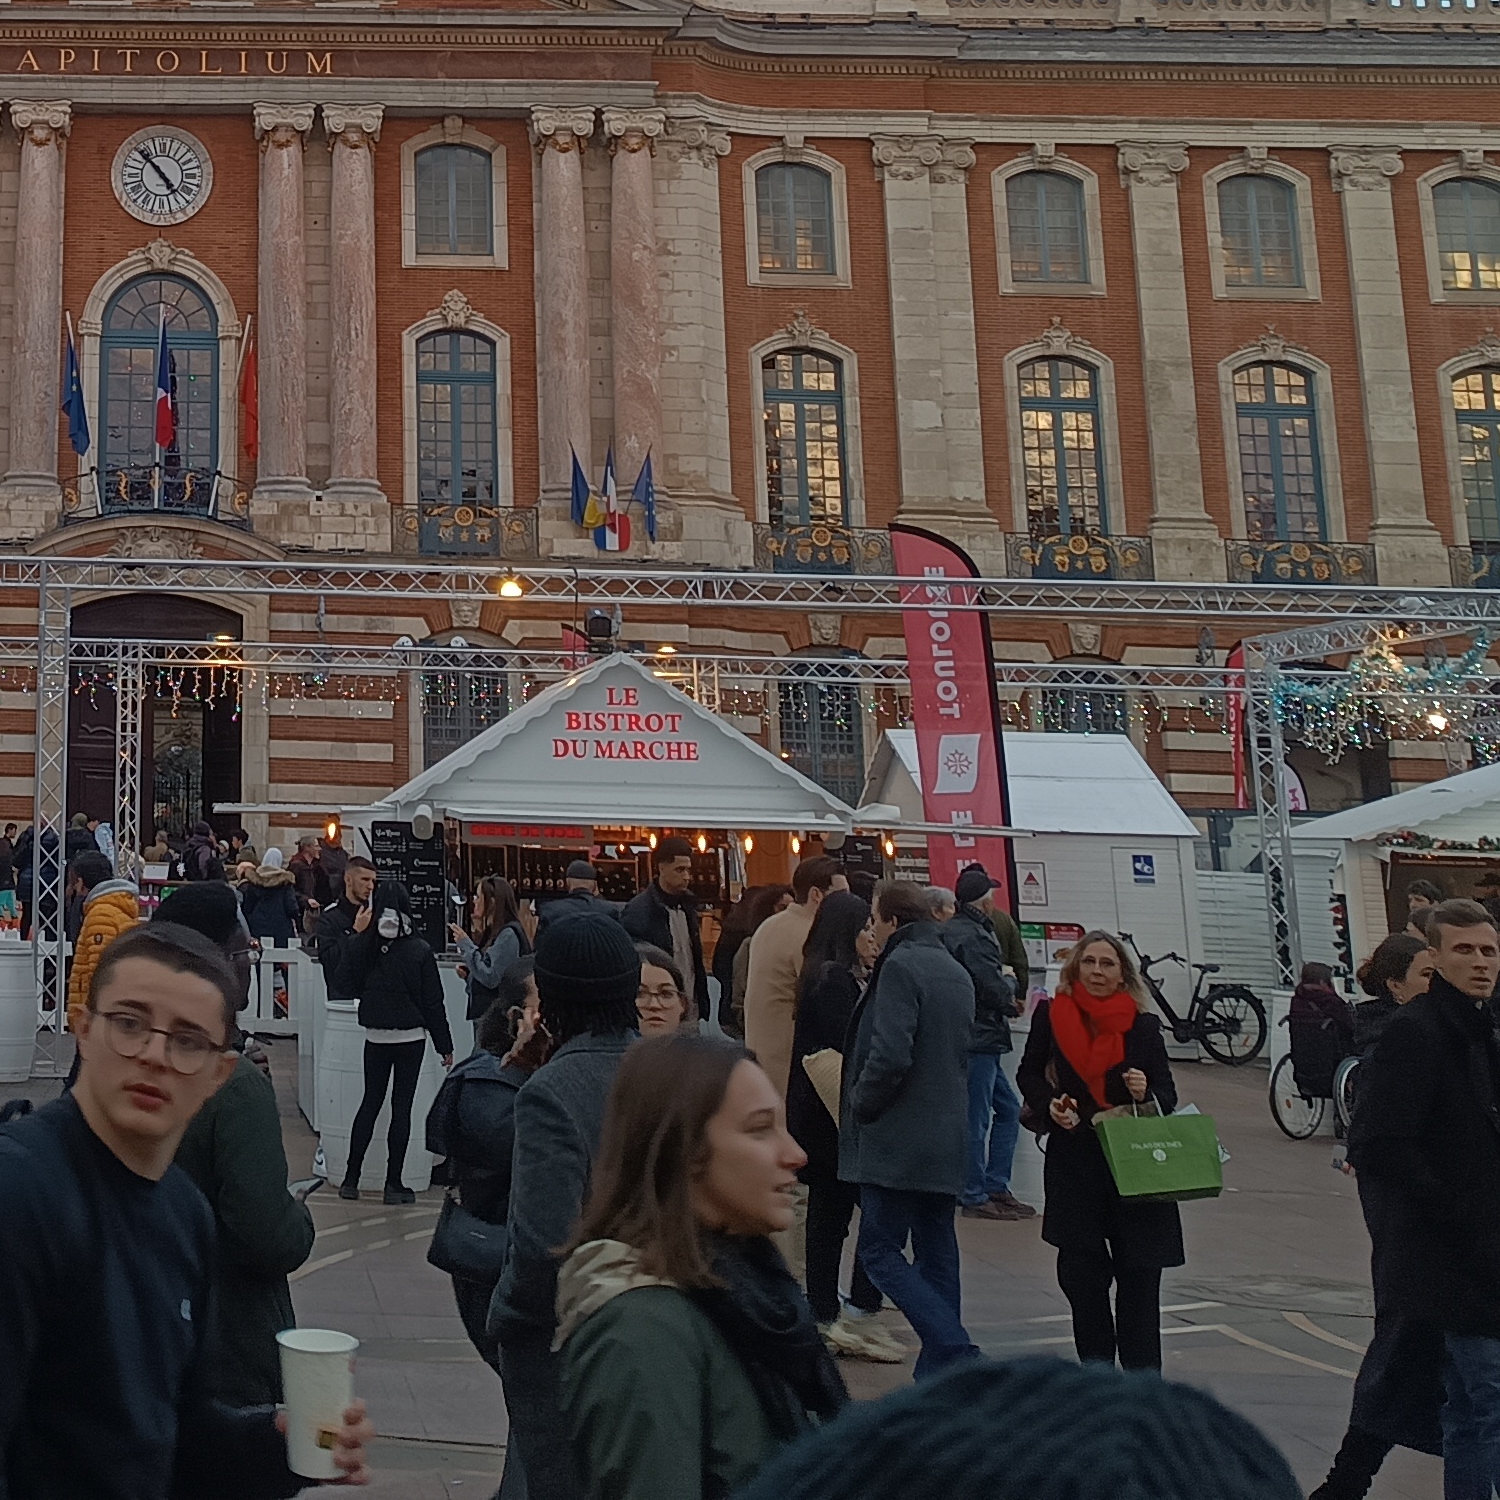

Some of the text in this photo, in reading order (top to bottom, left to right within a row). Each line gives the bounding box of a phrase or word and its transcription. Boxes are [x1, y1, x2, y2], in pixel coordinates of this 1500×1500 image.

[606, 687, 639, 706] LE
[565, 711, 682, 733] BISTROT
[552, 738, 700, 761] DU MARCHE
